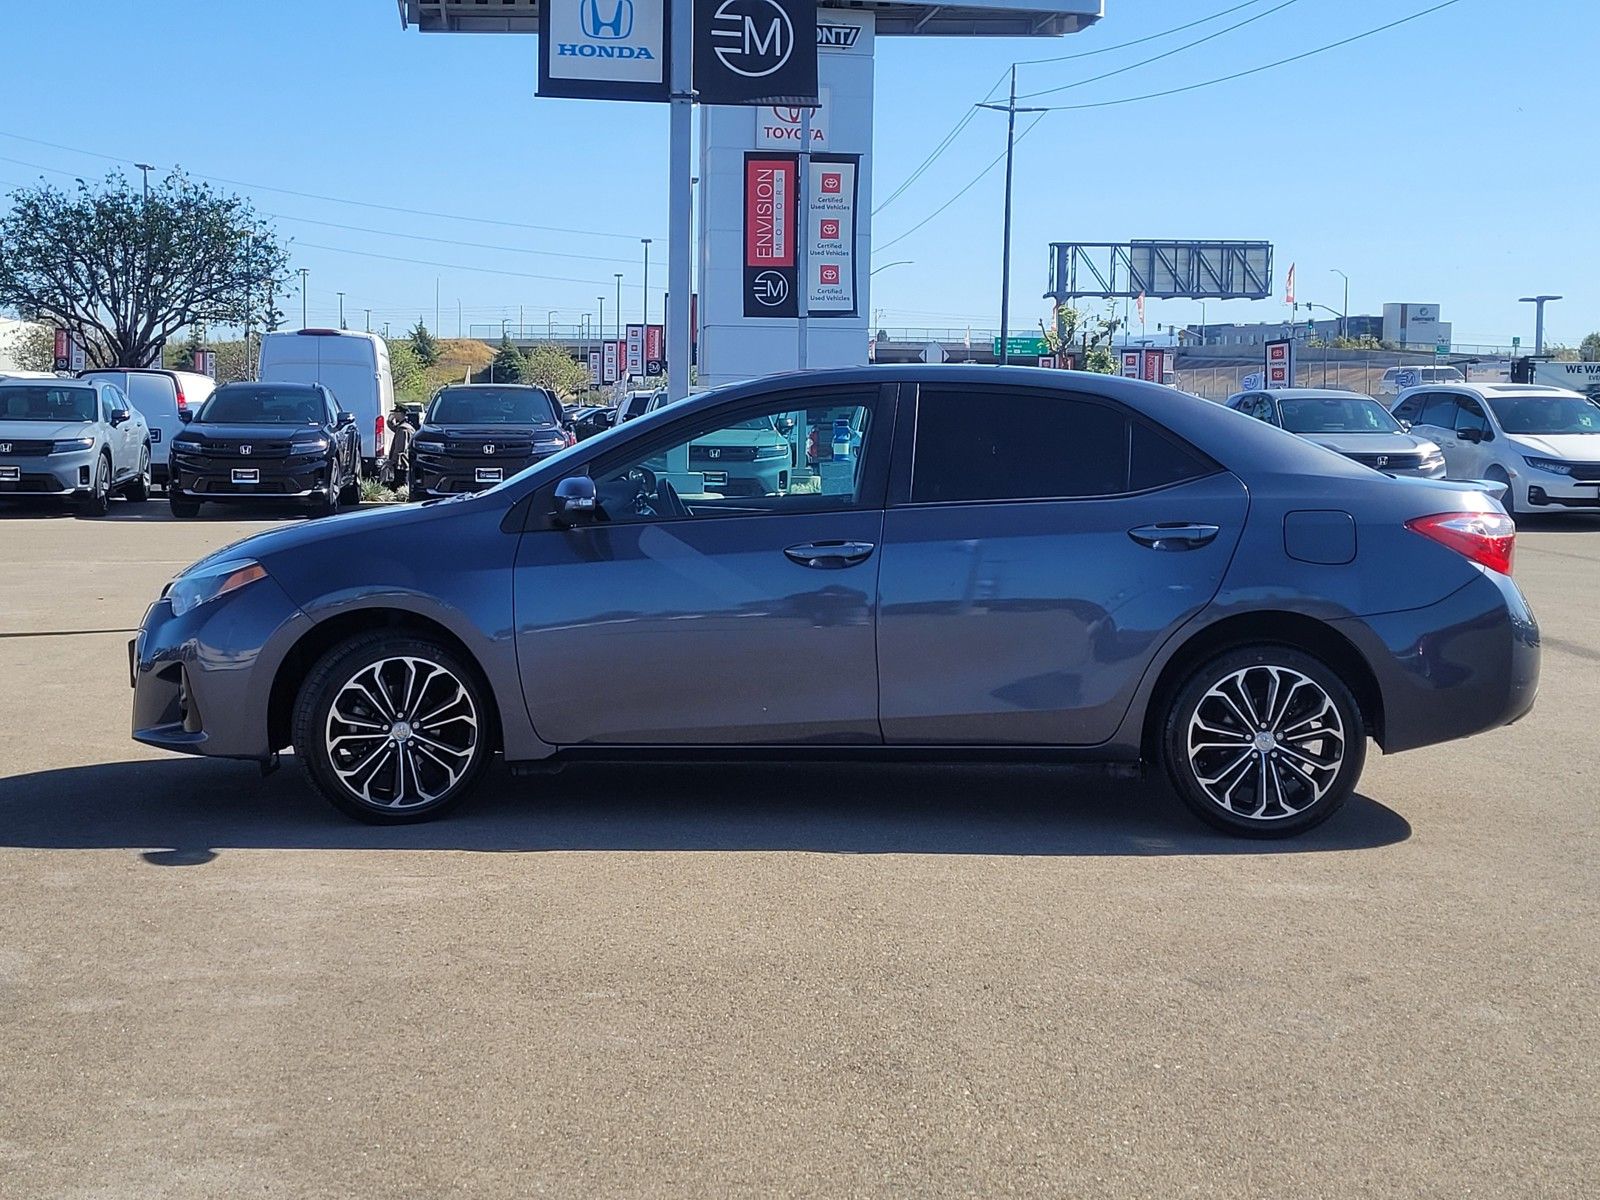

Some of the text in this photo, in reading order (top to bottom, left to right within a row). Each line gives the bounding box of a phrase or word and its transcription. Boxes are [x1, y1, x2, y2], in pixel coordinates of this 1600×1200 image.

[557, 43, 655, 60] HONDA
[764, 126, 824, 141] TOYOTA
[756, 169, 772, 258] ENVISION
[775, 177, 783, 251] MOTORS
[1565, 365, 1582, 374] WE
